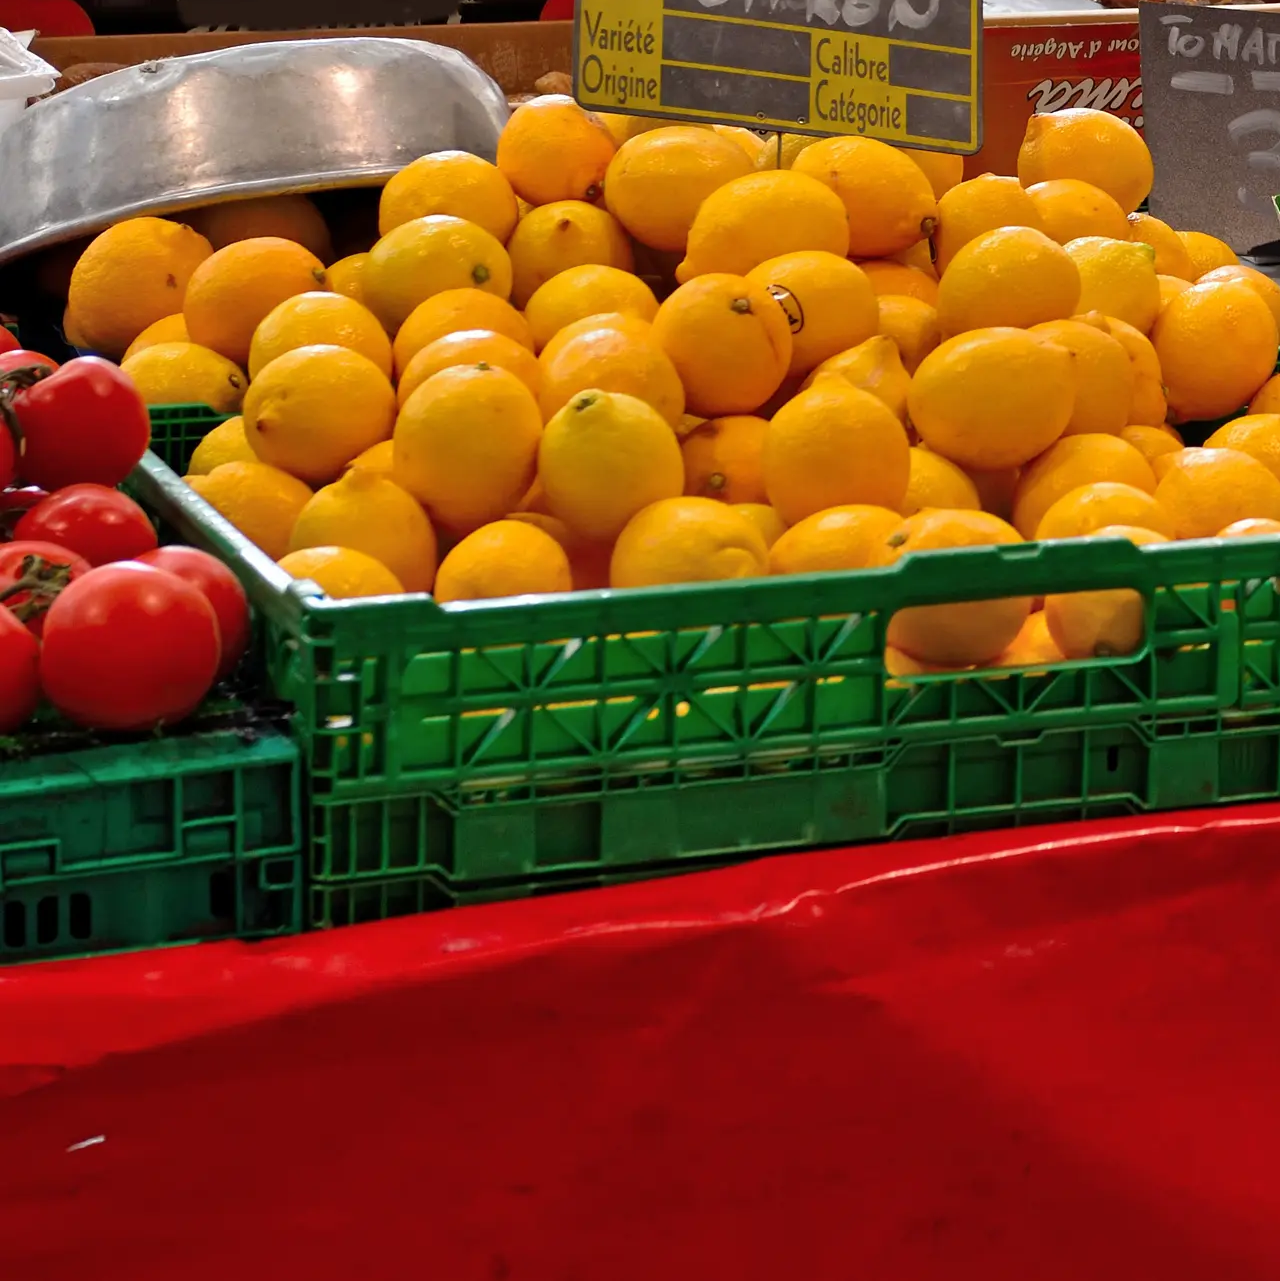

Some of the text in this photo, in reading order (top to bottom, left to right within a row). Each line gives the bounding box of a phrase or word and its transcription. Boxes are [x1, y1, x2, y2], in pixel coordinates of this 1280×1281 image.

[585, 9, 888, 82] Variété Calibre
[1011, 38, 1141, 62] our d'Algérie
[582, 54, 902, 134] Origine Catégorie
